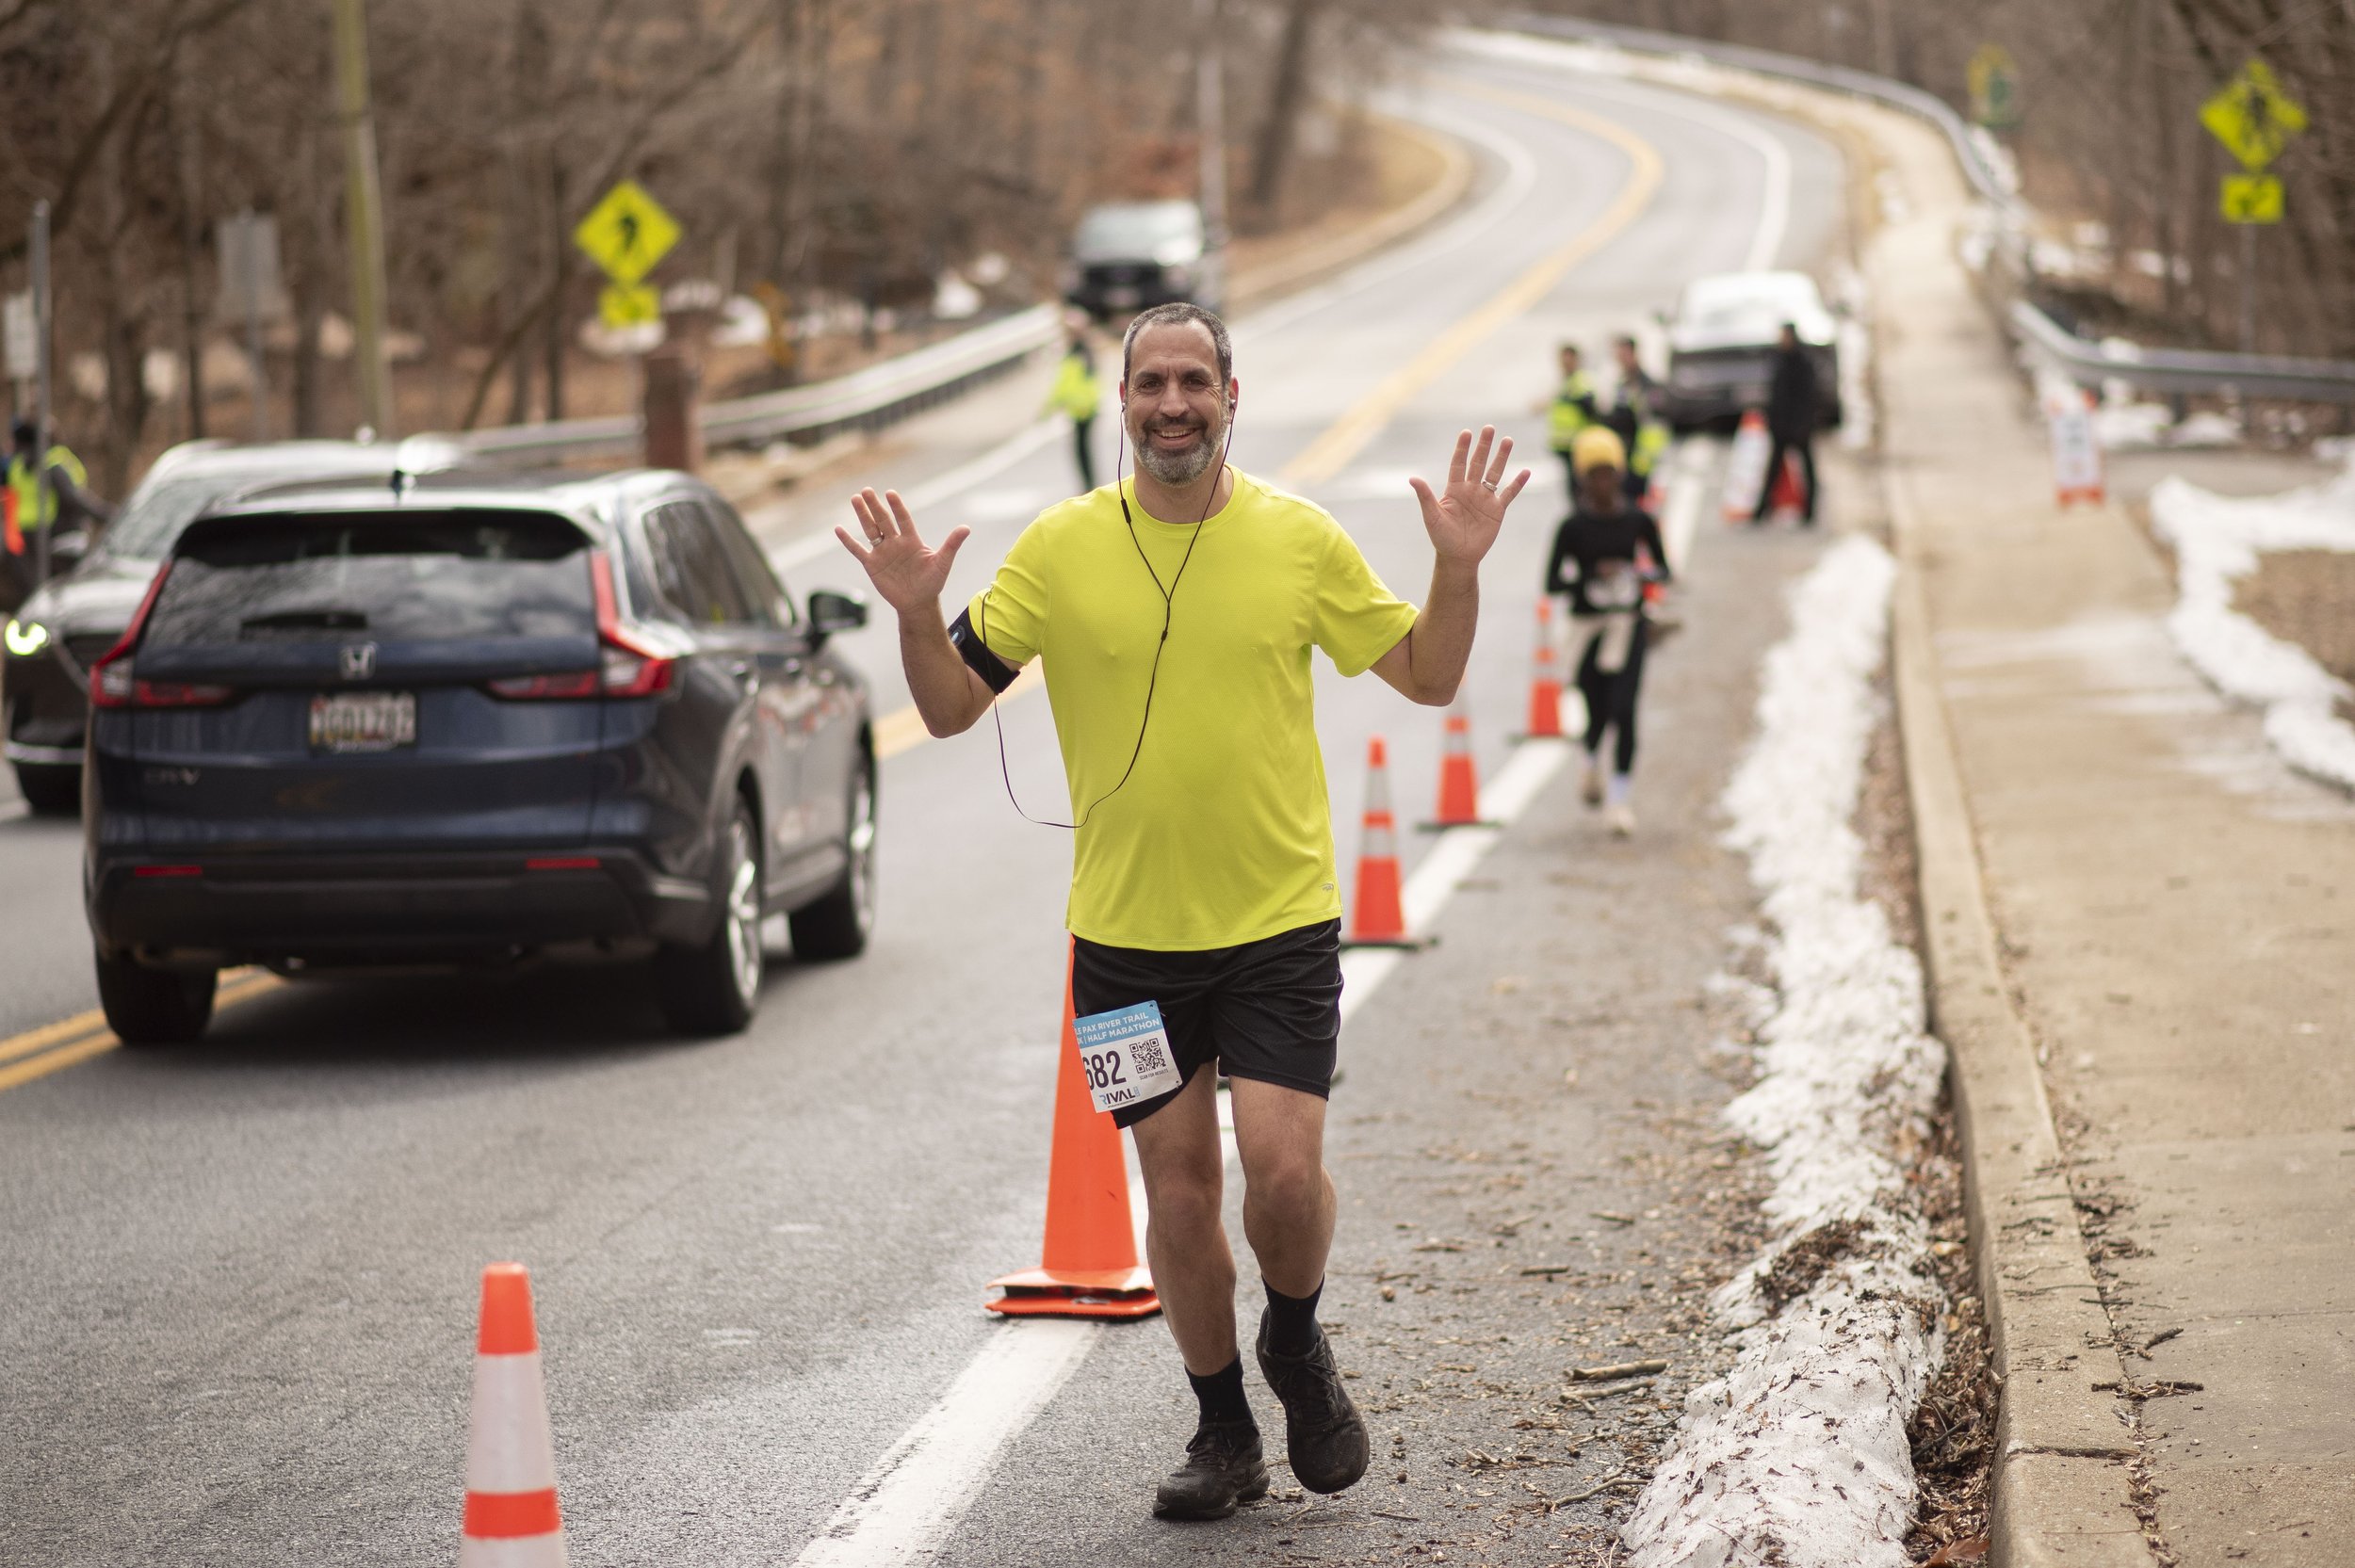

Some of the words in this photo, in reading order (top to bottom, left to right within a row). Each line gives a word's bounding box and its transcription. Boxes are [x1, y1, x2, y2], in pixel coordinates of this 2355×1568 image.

[1082, 1024, 1097, 1034] PAX
[1097, 1018, 1121, 1030] RIVER
[1123, 1011, 1149, 1025] TRAIL
[1087, 1031, 1107, 1043] HALF
[1109, 1018, 1161, 1038] MARATHON
[1098, 1088, 1136, 1105] RIVAL
